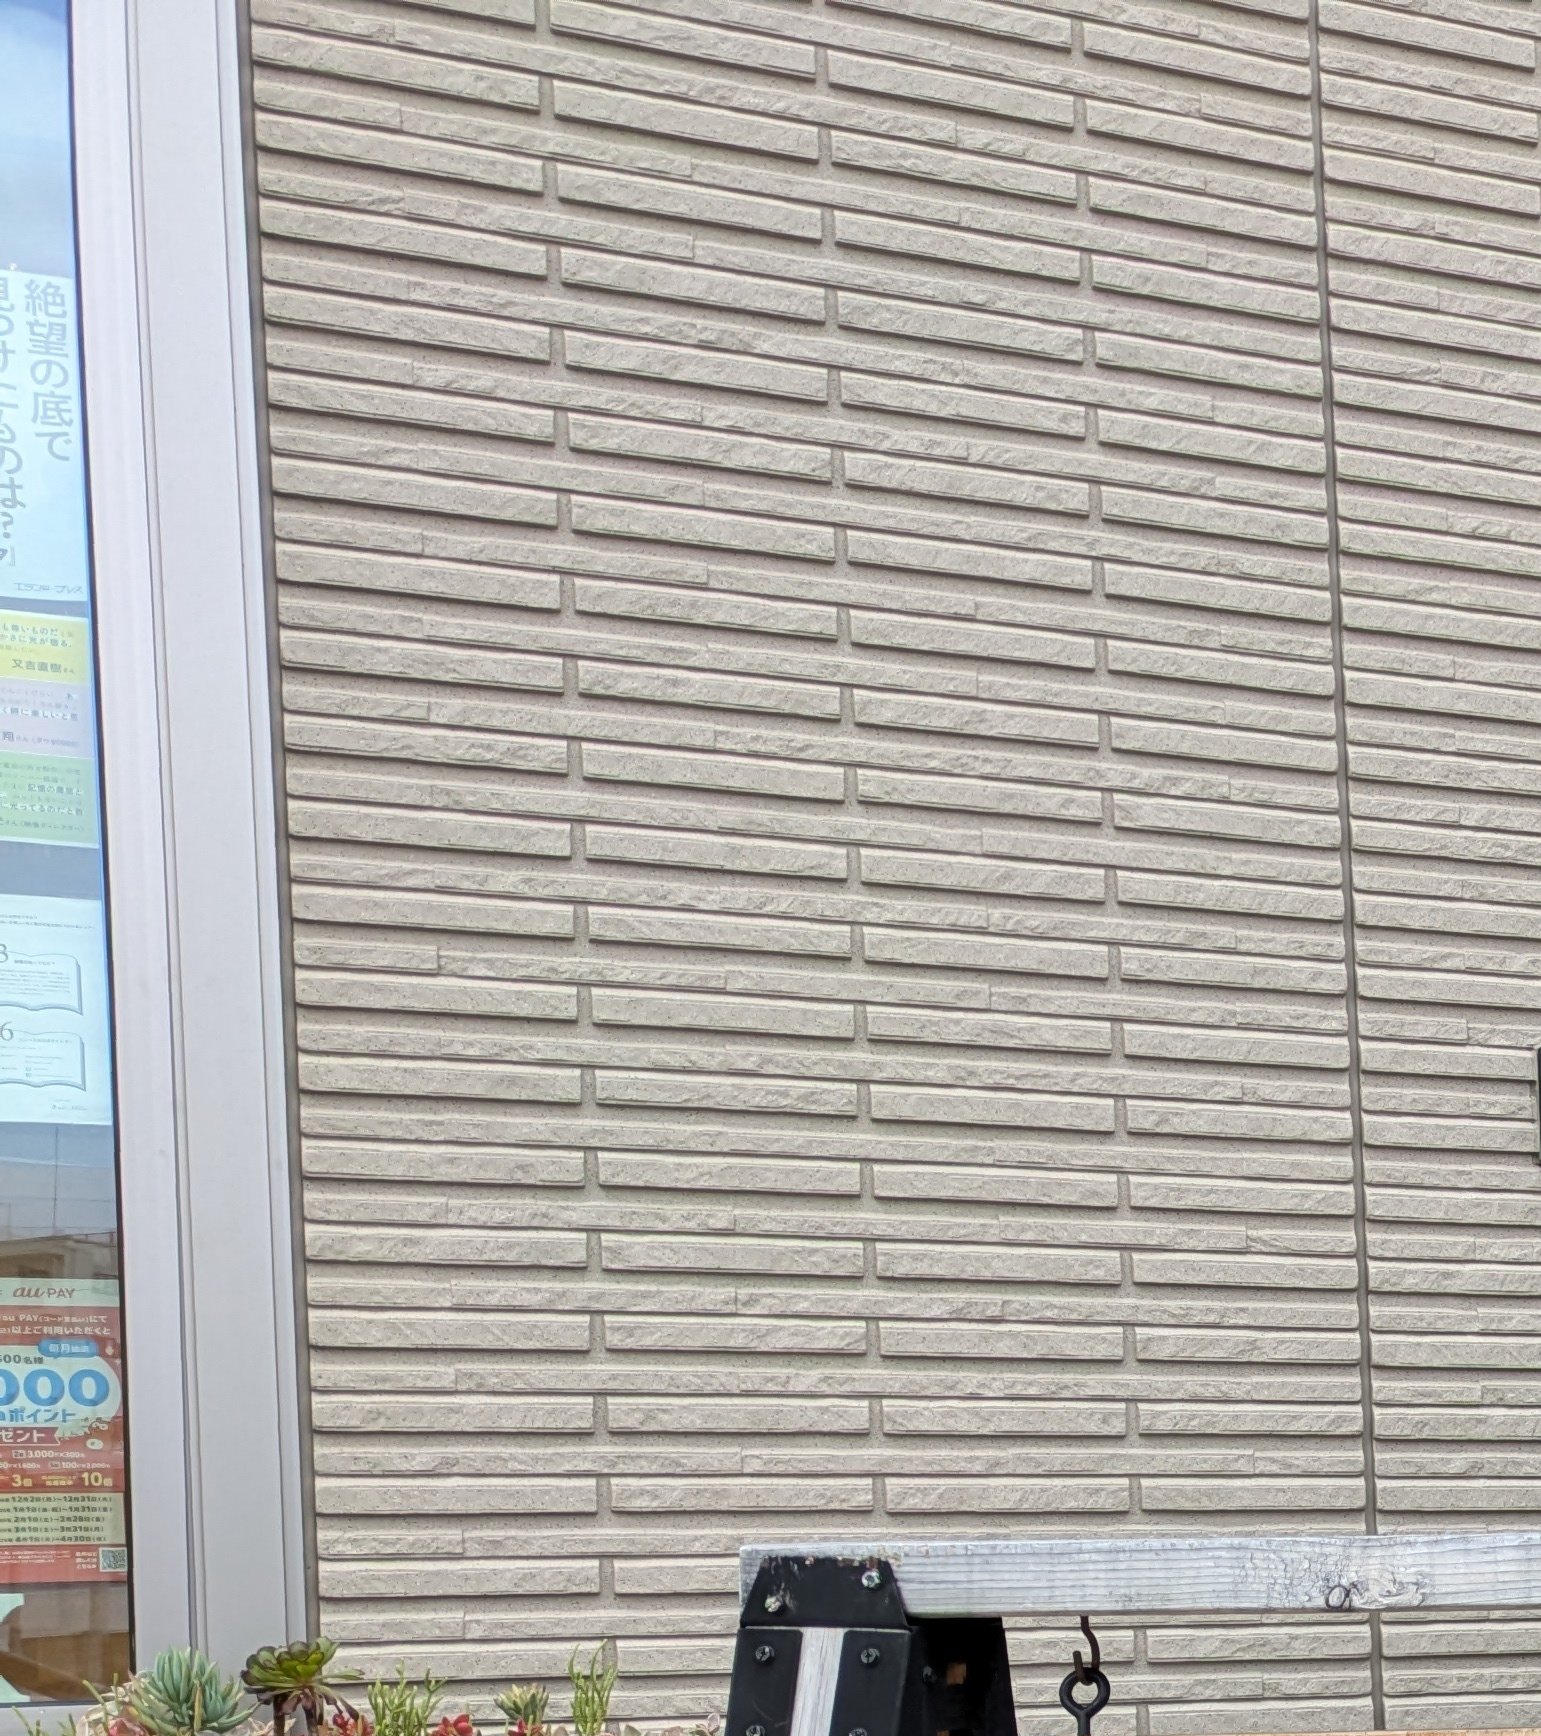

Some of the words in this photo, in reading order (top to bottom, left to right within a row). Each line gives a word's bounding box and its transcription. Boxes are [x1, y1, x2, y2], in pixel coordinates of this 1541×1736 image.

[25, 279, 75, 461] 絶望の底で
[12, 1287, 45, 1298] au
[47, 1288, 75, 1298] PAY
